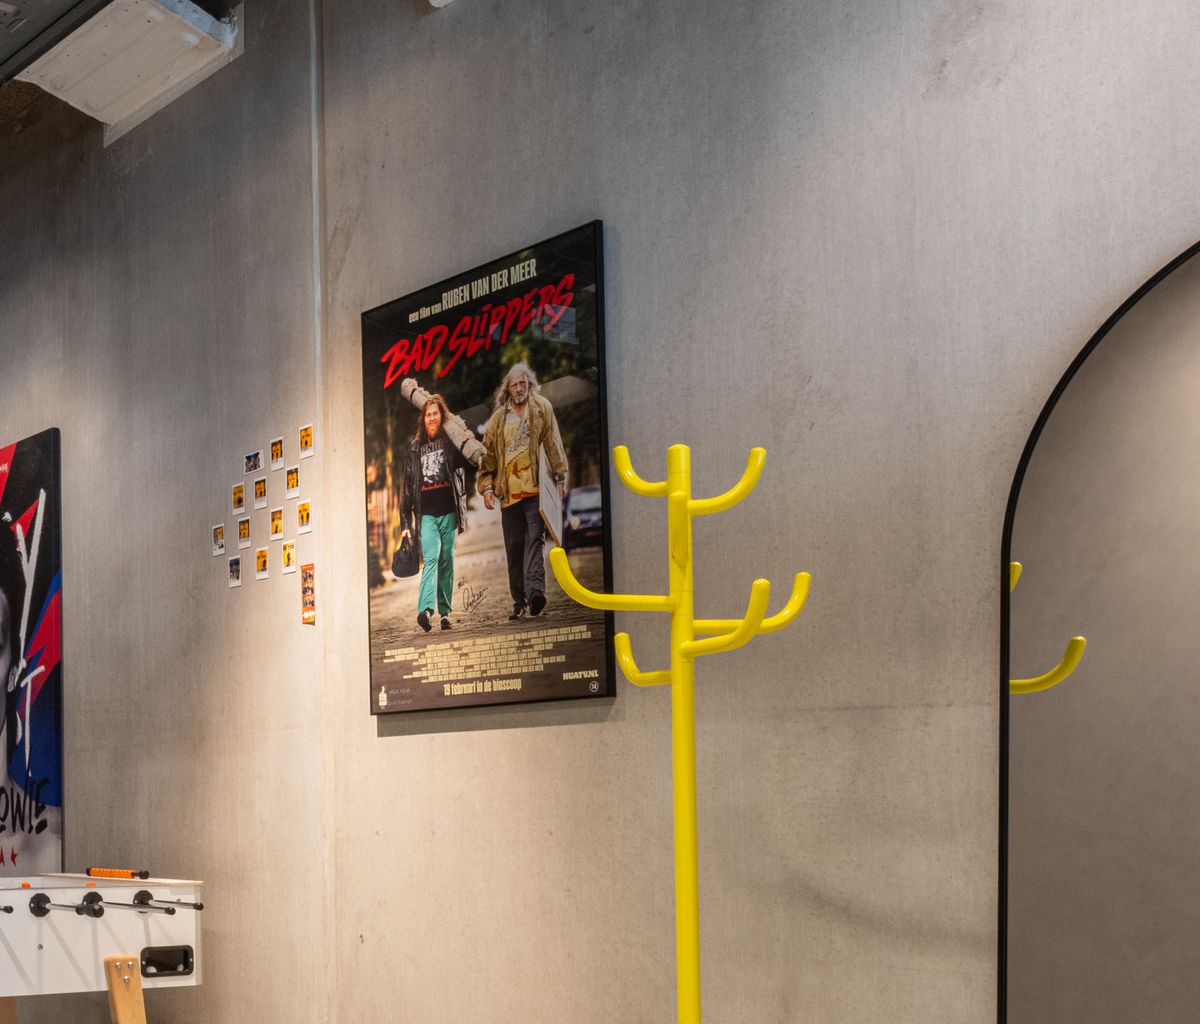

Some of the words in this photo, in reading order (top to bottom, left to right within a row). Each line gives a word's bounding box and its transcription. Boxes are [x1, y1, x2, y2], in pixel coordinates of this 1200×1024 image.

[408, 312, 419, 323] een
[419, 306, 431, 320] film
[431, 302, 441, 316] van
[441, 286, 470, 310] RUBEN
[471, 278, 490, 299] VAN
[491, 271, 508, 292] DER
[510, 258, 537, 286] MEER
[381, 325, 448, 389] BAD
[451, 680, 477, 695] februari
[477, 680, 484, 694] in
[484, 679, 492, 693] de
[492, 678, 522, 692] bioscoop
